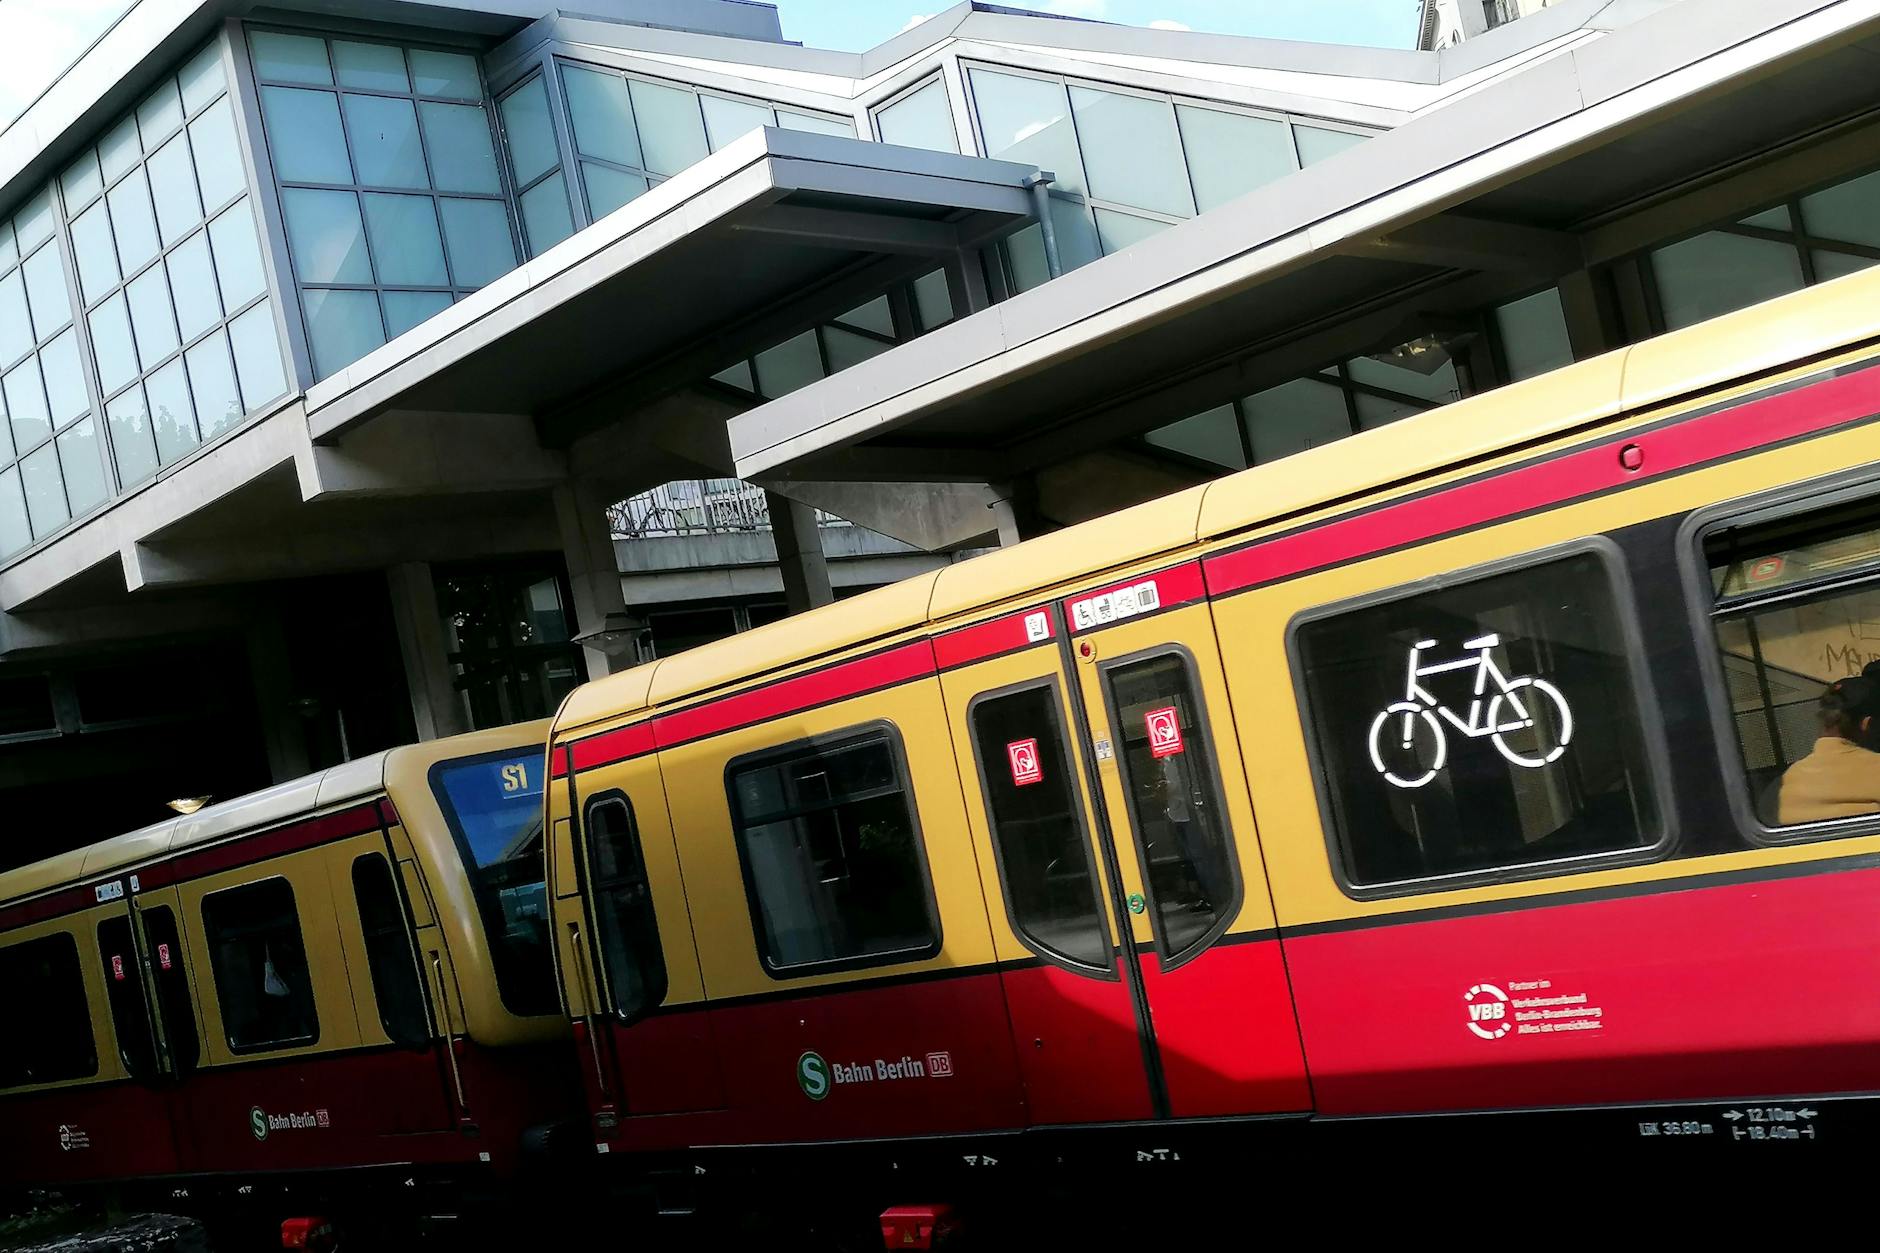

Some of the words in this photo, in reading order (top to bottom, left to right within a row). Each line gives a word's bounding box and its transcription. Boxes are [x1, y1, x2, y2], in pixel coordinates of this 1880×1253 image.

[502, 763, 528, 791] S1
[1467, 1002, 1506, 1021] VBB
[801, 1056, 827, 1095] S
[832, 1062, 873, 1084] Bahn
[875, 1056, 925, 1080] Berlin
[928, 1053, 951, 1076] DB
[252, 1108, 266, 1137] S
[268, 1113, 290, 1130] Bahn
[290, 1111, 316, 1128] Berlin
